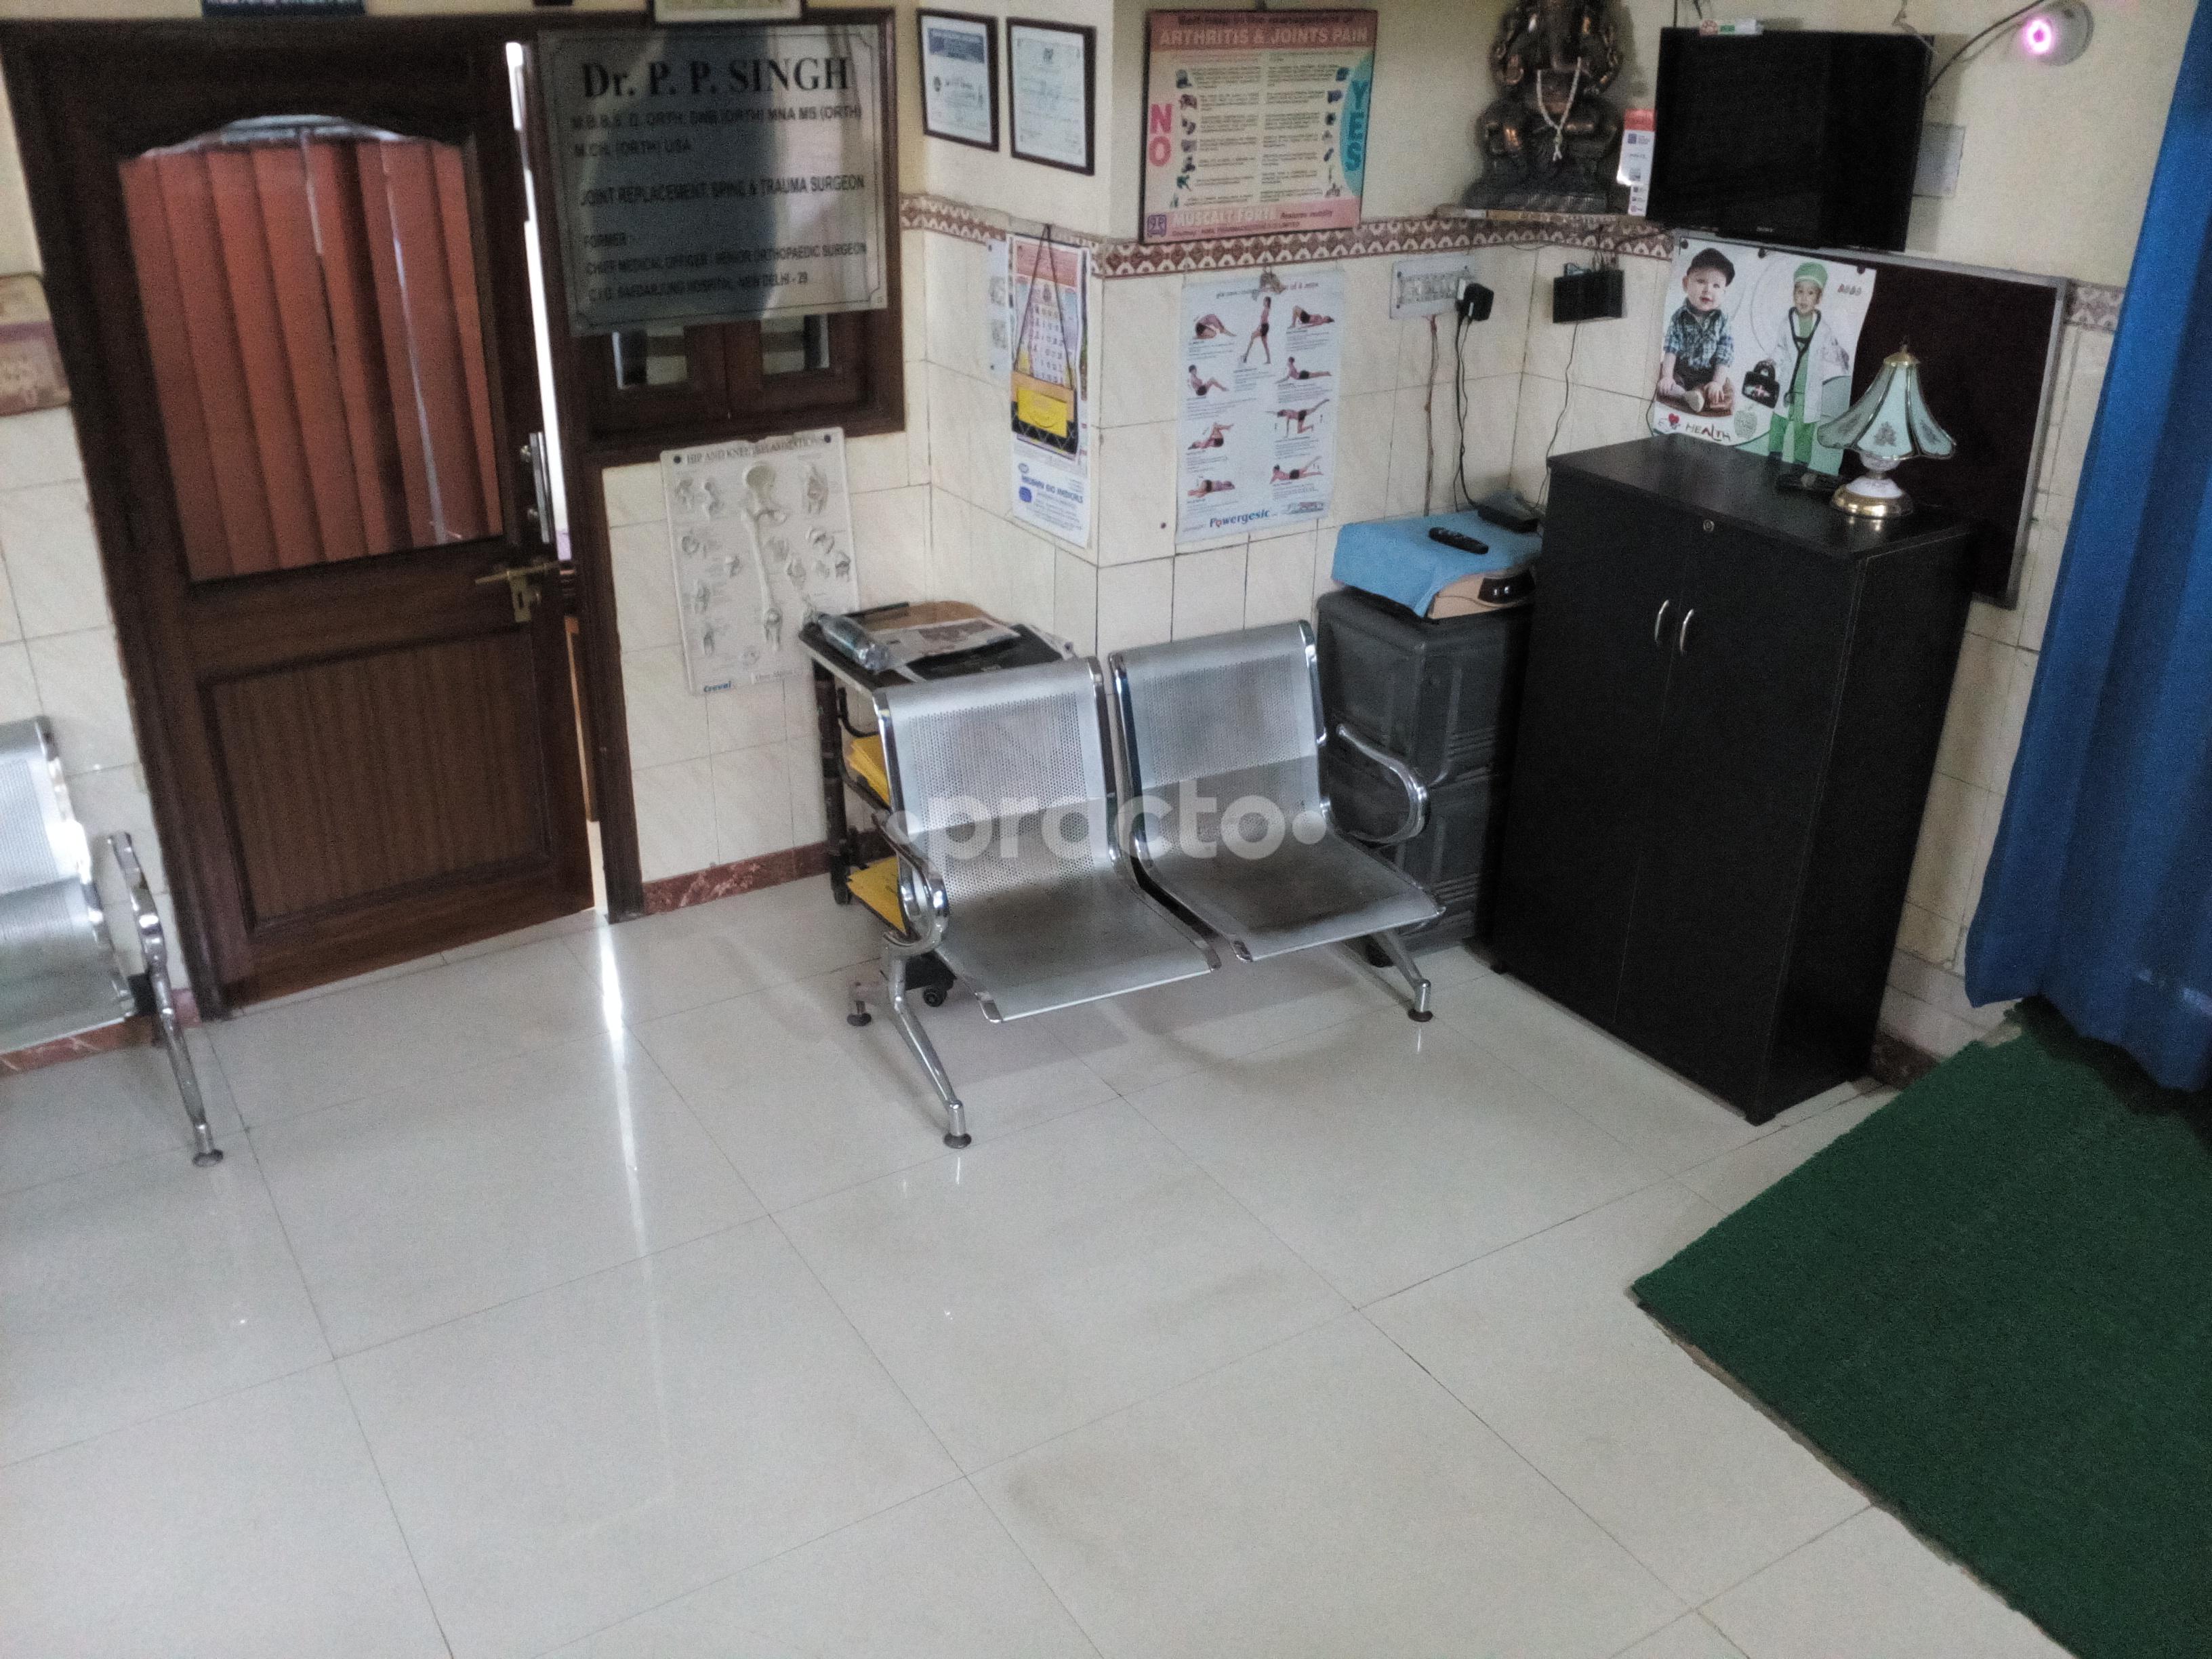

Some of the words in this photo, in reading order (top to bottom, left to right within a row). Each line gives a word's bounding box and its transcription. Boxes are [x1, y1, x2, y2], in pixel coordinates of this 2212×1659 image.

[1158, 28, 1249, 45] ARTHRITIS
[1252, 28, 1265, 43] &
[1271, 26, 1328, 43] JOINTS
[1332, 25, 1368, 42] PAIN
[582, 61, 636, 98] Dr.
[649, 60, 677, 96] P.
[690, 60, 718, 94] P.
[729, 57, 850, 92] SINGH
[1149, 103, 1174, 167] NO
[1345, 79, 1370, 172] YES
[760, 176, 807, 195] TRAUMA
[809, 173, 865, 192] SURGEON
[753, 245, 821, 263] ORTHOPAEDIC
[822, 242, 867, 258] SURGEON
[1685, 422, 1732, 442] HEALTH
